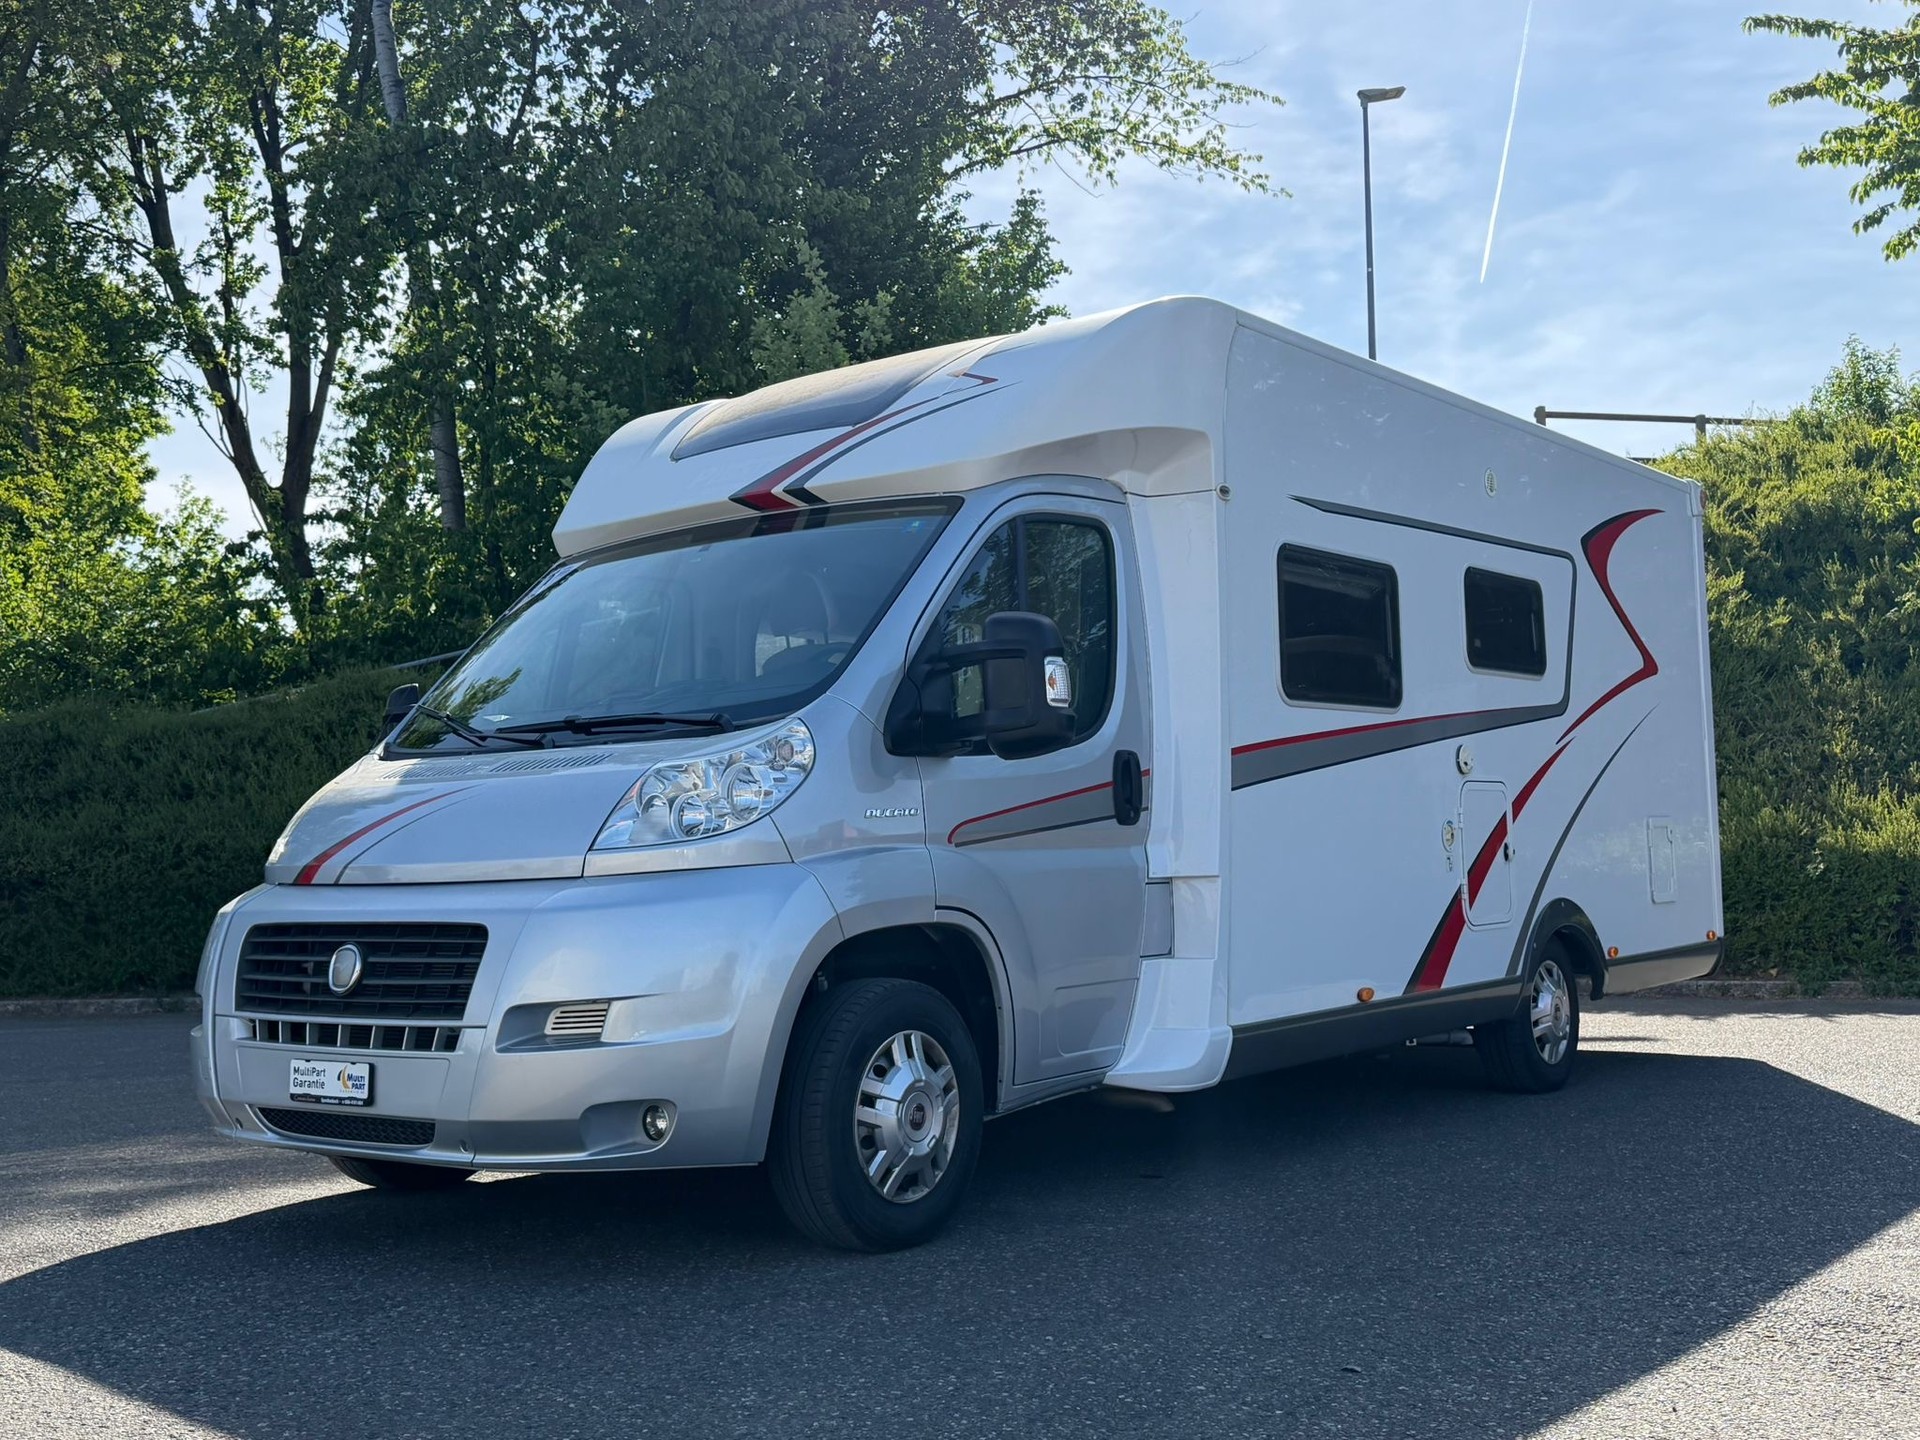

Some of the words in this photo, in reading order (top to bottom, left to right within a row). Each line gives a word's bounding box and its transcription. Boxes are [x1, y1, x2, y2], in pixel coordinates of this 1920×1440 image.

[864, 808, 920, 818] DUCATO
[293, 1066, 326, 1077] MultiPart
[292, 1077, 325, 1089] Garantie
[352, 1082, 365, 1090] PART
